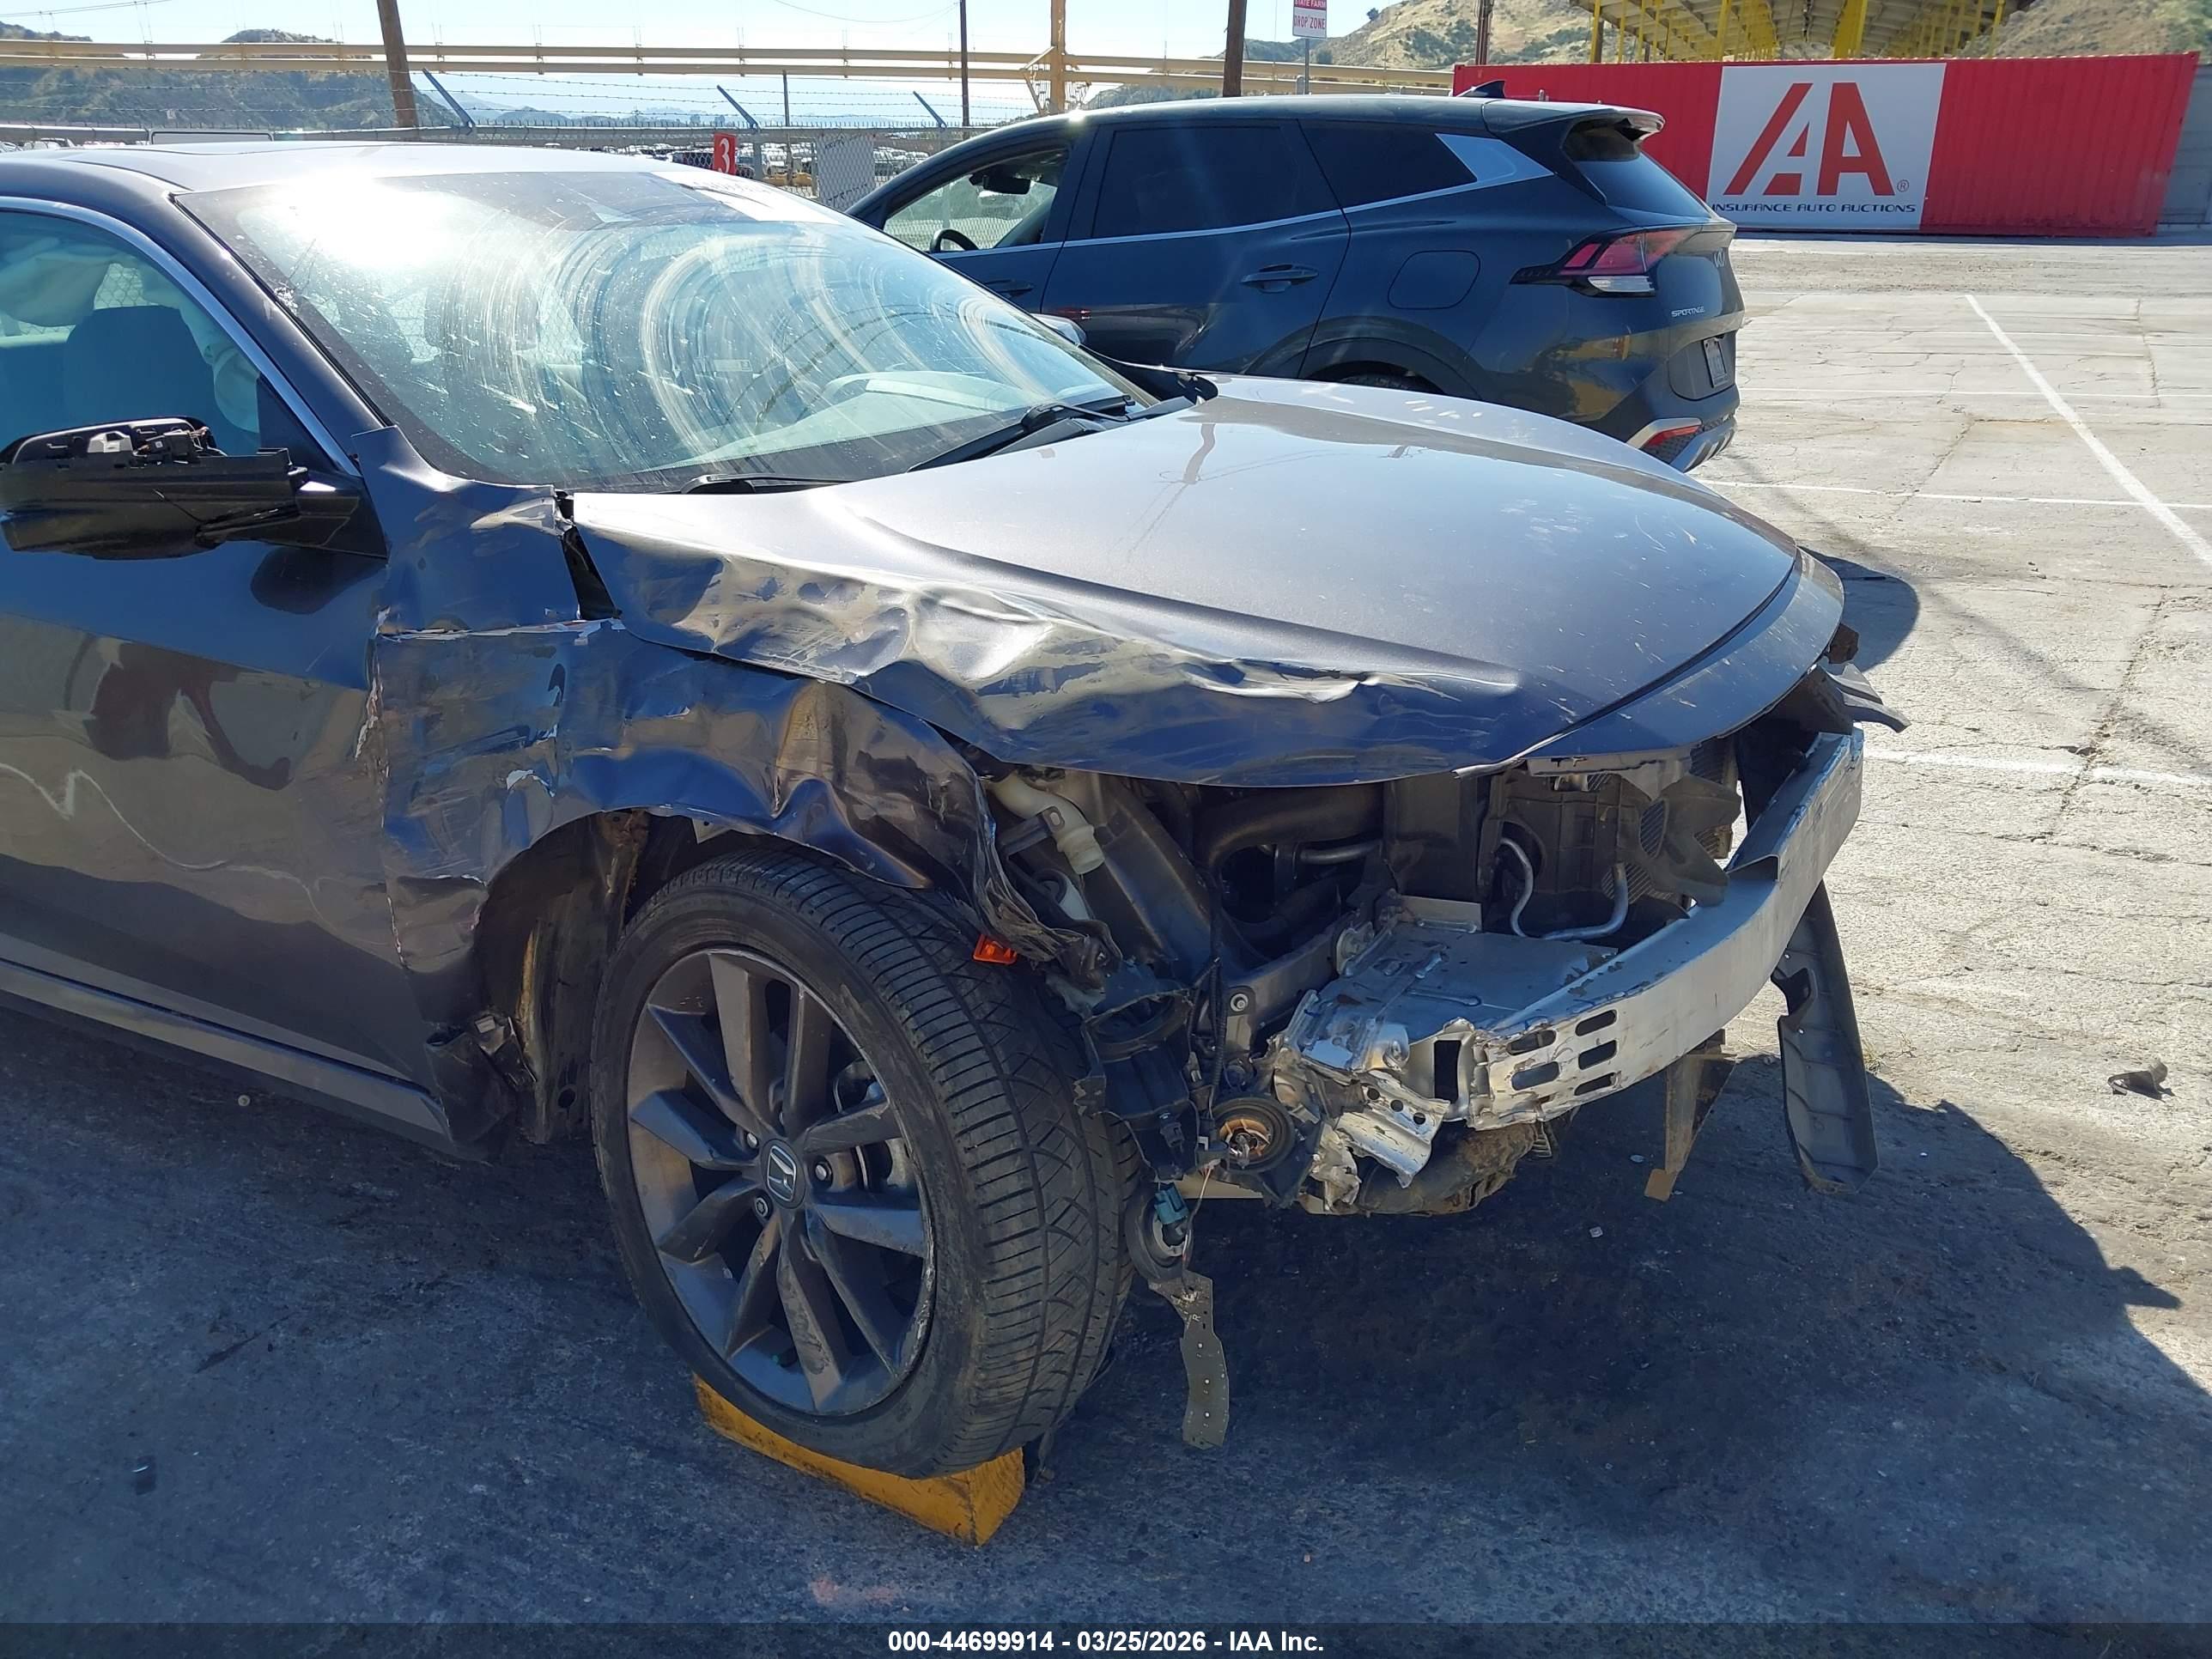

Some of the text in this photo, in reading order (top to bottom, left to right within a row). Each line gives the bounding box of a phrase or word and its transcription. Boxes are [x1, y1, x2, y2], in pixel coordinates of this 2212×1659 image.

[1294, 15, 1325, 29] DROP ZONE
[719, 137, 730, 173] 3
[1712, 204, 1917, 213] INSURANCE AUTO AUCTIONS
[1671, 306, 1705, 318] SPORTAGE
